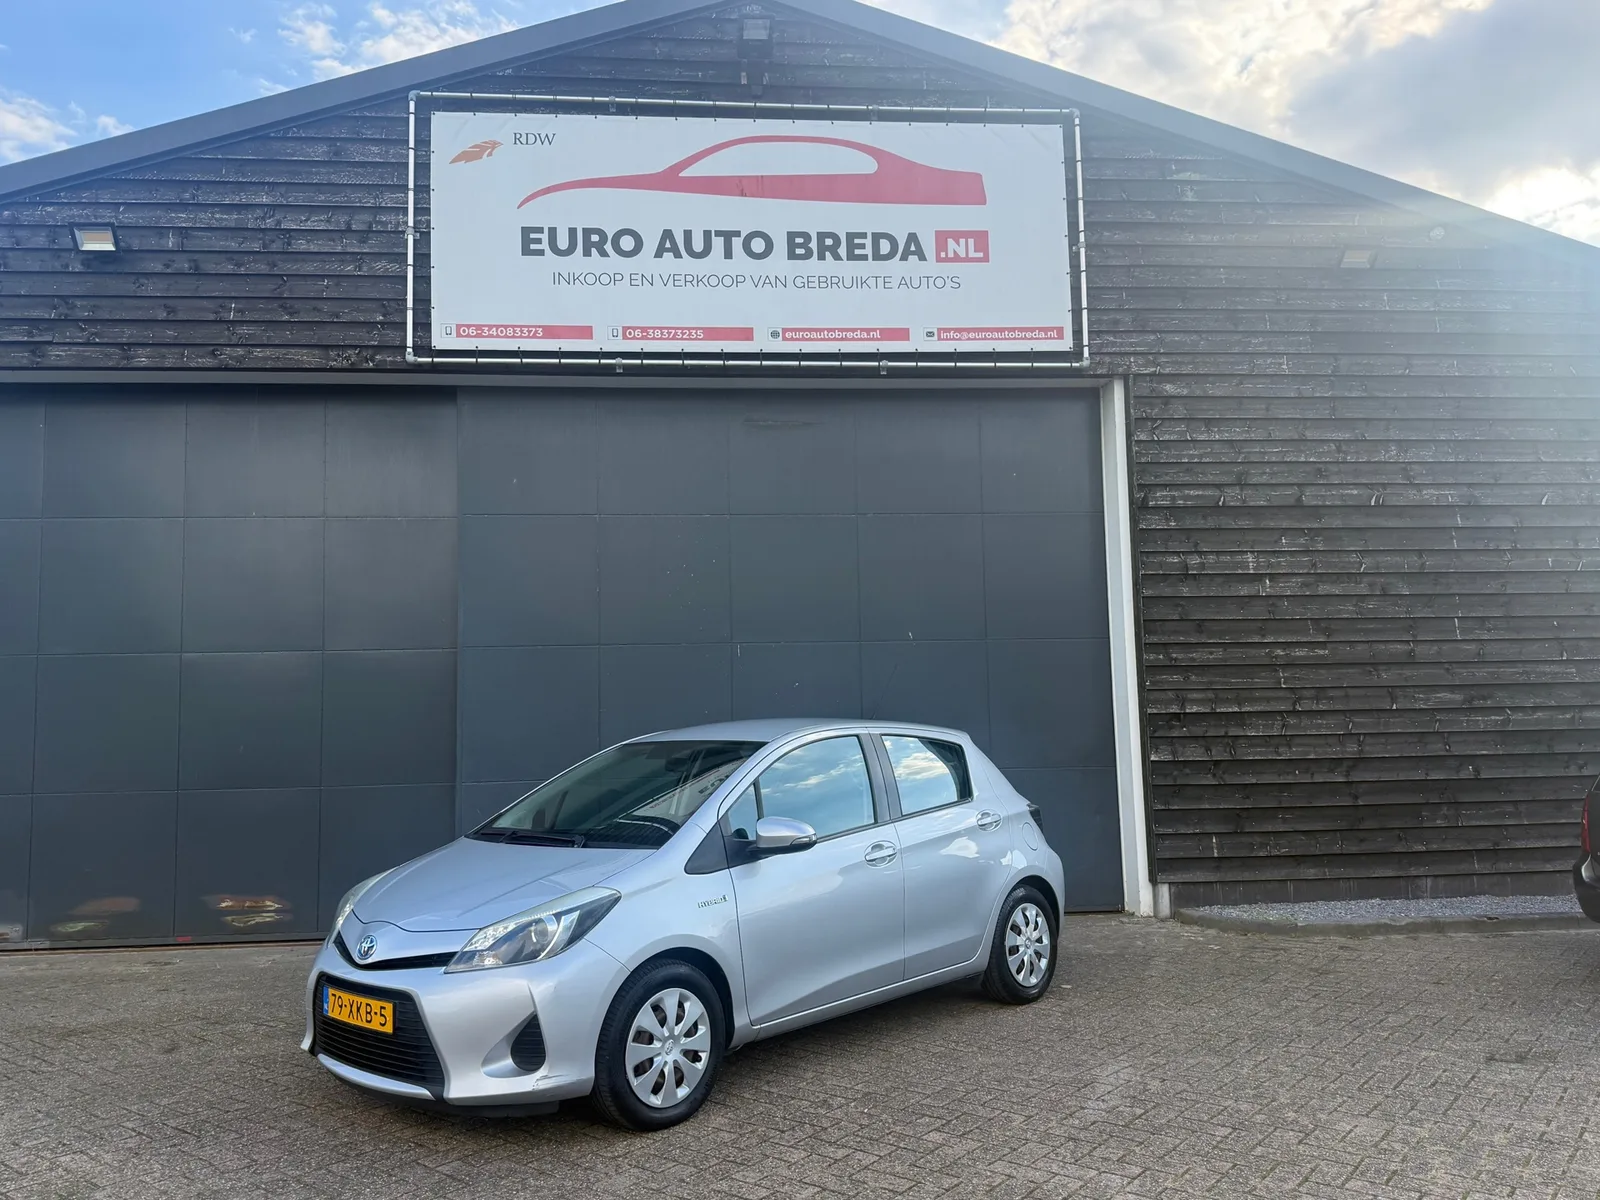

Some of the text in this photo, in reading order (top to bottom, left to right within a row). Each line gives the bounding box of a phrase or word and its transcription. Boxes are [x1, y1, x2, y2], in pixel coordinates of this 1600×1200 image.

[512, 132, 556, 146] RDW
[520, 226, 984, 262] EURO AUTO BREDA .NL
[552, 271, 961, 290] INKOOP EN VERKOOP VAN GEBRUIKTE AUTO'S
[459, 326, 544, 338] 06-34083373
[625, 328, 704, 339] 06-38373235
[785, 329, 881, 340] euroautobreda.nl
[939, 329, 1058, 340] info@euroautobreda.nl
[331, 993, 388, 1027] 79-XKB-5
